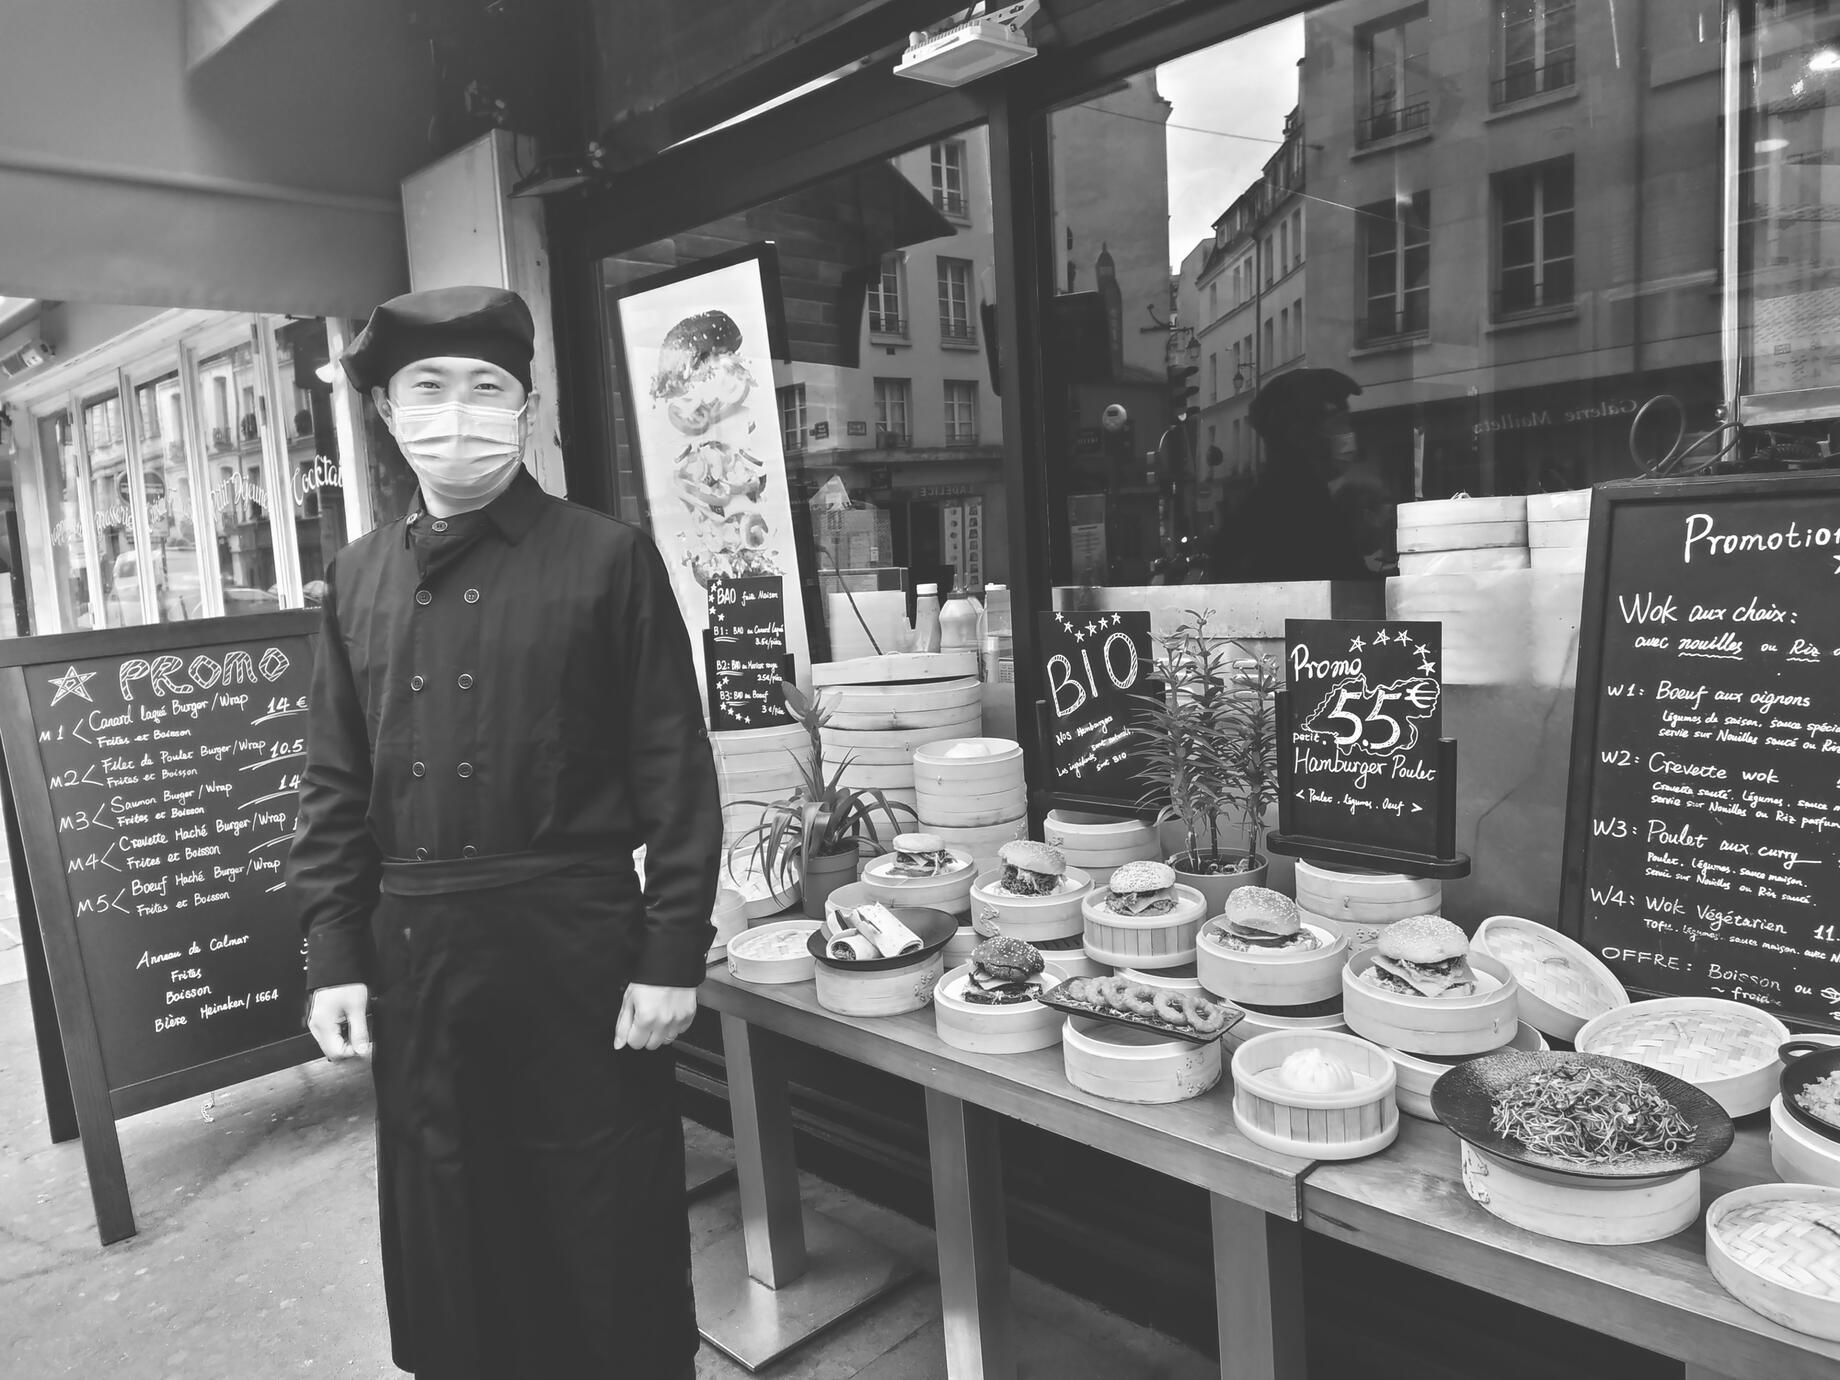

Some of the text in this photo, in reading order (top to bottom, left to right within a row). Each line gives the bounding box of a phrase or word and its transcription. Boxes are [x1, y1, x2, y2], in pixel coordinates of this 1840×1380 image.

[290, 454, 345, 505] Cocktai
[717, 588, 736, 605] BAO
[1619, 592, 1678, 624] Wok
[1688, 604, 1727, 622] aux
[1634, 634, 1669, 649] avec
[1678, 632, 1743, 654] nouilles
[1761, 642, 1778, 653] ou
[1789, 639, 1821, 657] Riz
[119, 648, 289, 701] PROMO
[1047, 632, 1138, 717] BIO
[1290, 643, 1362, 682] Promo
[89, 705, 133, 731] Canard
[140, 701, 167, 724] laqué
[267, 697, 289, 714] 14
[297, 696, 308, 708] €
[1715, 690, 1743, 703] aux
[1750, 690, 1811, 714] oignons
[1662, 709, 1702, 728] Légumes
[1705, 712, 1719, 723] de
[1769, 718, 1802, 729] sauce
[97, 728, 192, 749] Frites et Boisson
[1658, 728, 1689, 738] servie
[1716, 729, 1758, 745] Nouilles
[1765, 737, 1799, 748] sauté
[1803, 742, 1816, 750] ou
[102, 758, 135, 774] Filet
[140, 752, 154, 766] de
[160, 750, 194, 765] Poulet
[270, 739, 304, 759] 10.5
[1112, 752, 1127, 763] BIO
[1294, 746, 1437, 790] Hamburger Poulet
[1649, 752, 1728, 779] Crevette
[1742, 769, 1779, 784] wok
[50, 771, 81, 790] M2
[106, 766, 198, 788] Frites et Boisson
[110, 795, 157, 814] Saumon
[1651, 795, 1681, 807] servie
[1686, 800, 1705, 808] sur
[1708, 801, 1747, 817] Nouilles
[1755, 811, 1769, 819] ou
[1776, 810, 1797, 824] Riz
[1652, 782, 1694, 795] Crevette
[1797, 800, 1828, 811] sauce
[59, 811, 89, 833] M3
[116, 806, 205, 828] Frites et Boisson
[119, 834, 168, 851] Crevette
[175, 822, 208, 840] Haché
[1593, 817, 1822, 870] W3: Poulet aux curry
[68, 854, 98, 874] M4
[127, 844, 221, 870] Frites et Boisson
[176, 870, 205, 886] Haché
[1676, 873, 1692, 882] sur
[1697, 875, 1731, 890] Nouilles
[1739, 884, 1752, 893] ou
[1758, 886, 1777, 899] Riz
[1740, 868, 1766, 879] sauce
[77, 894, 109, 918] M5
[136, 890, 230, 917] Frites et Boisson
[1590, 885, 1636, 907] W4:
[1646, 895, 1686, 915] Wok
[1697, 904, 1788, 934] Végétarien
[136, 934, 250, 970] Anneau de Calmar
[1728, 936, 1758, 947] sauce
[1804, 950, 1827, 960] avec
[171, 968, 202, 983] Frites
[1708, 963, 1781, 992] Boisson
[1794, 984, 1813, 995] ou
[166, 986, 212, 1005] Boisson
[155, 1014, 188, 1033] Bière
[255, 988, 279, 1003] 1664
